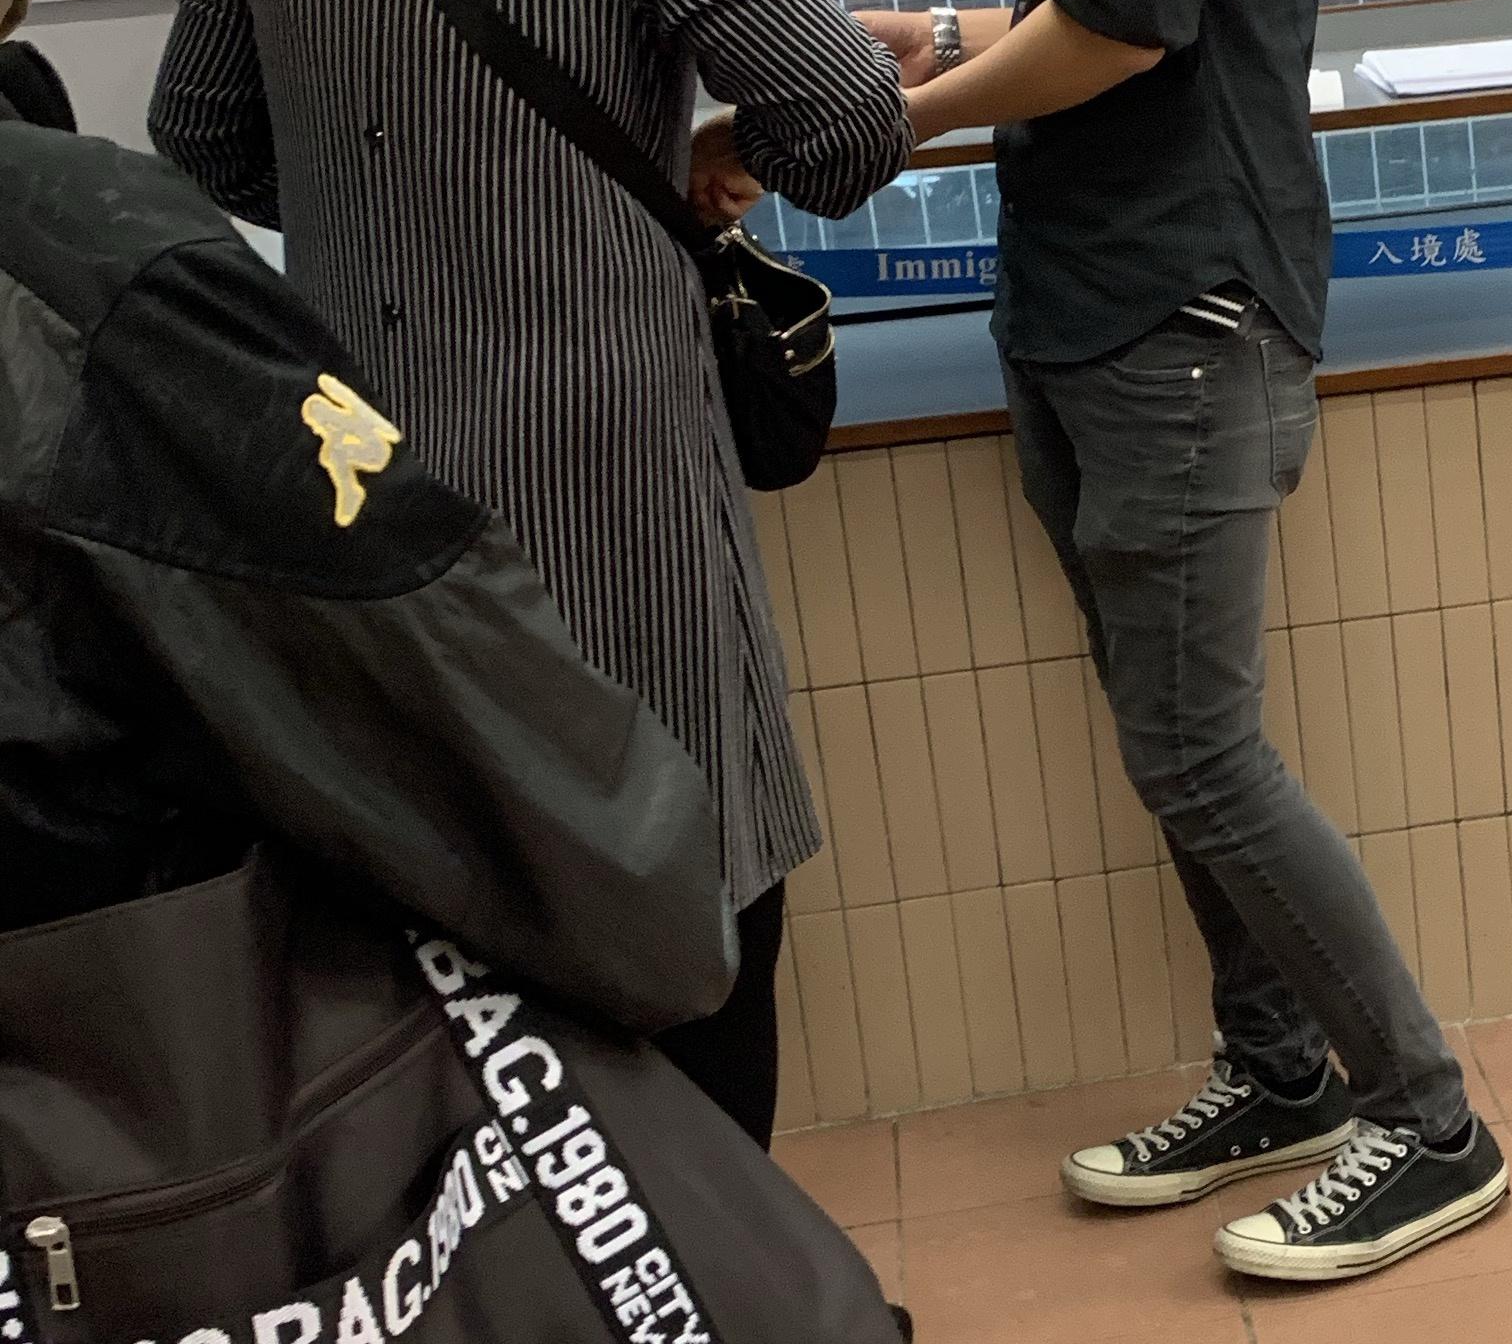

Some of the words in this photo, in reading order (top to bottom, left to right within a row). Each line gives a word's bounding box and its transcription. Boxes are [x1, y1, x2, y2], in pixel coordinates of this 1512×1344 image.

[1369, 227, 1487, 267] 入境處
[405, 929, 649, 1265] BAG.1980
